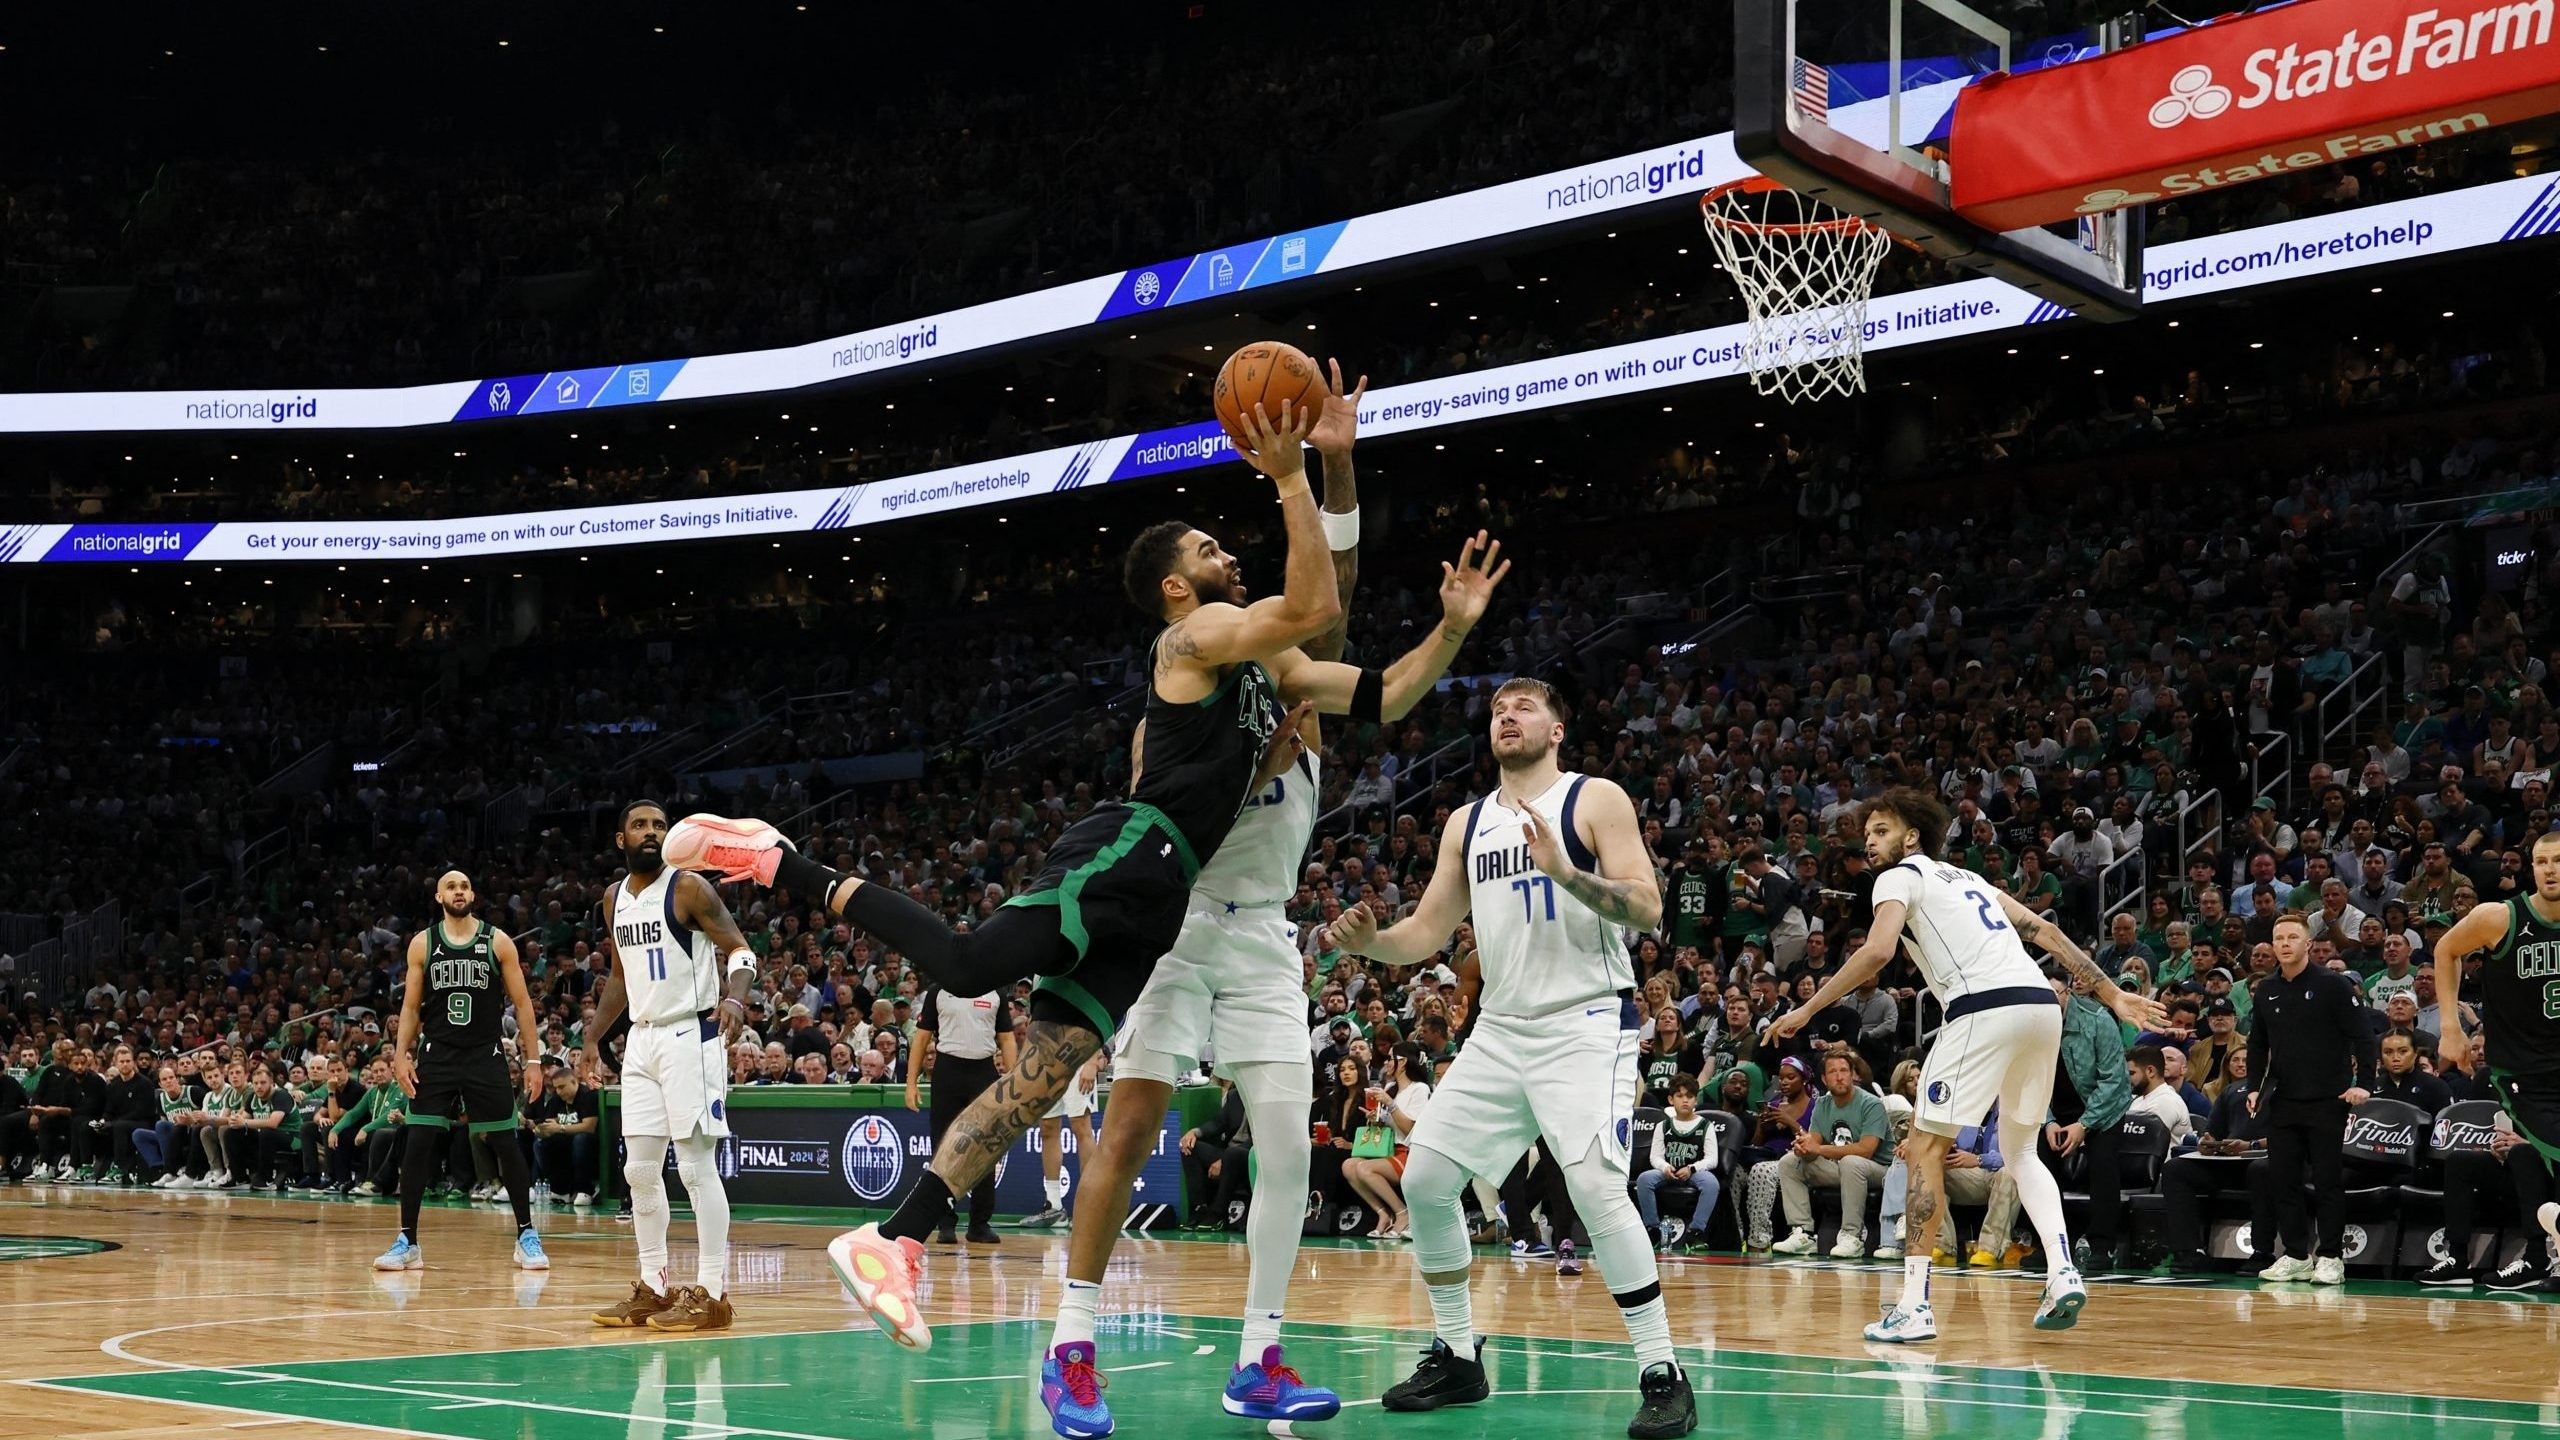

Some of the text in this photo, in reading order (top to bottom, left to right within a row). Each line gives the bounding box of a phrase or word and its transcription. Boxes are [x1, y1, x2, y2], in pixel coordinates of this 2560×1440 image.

[2238, 0, 2557, 110] State Farm
[2160, 112, 2490, 196] State Farm
[1548, 149, 1704, 210] nationalgrid
[2142, 219, 2433, 287] ngrid.com/heretohelp
[833, 324, 937, 368] nationalgrid
[1382, 386, 1510, 421] energy-saving
[1516, 376, 1569, 402] game
[1574, 371, 1598, 388] on
[1604, 359, 1646, 382] with
[1652, 356, 1687, 374] our
[1896, 299, 2001, 332] Initiative.
[187, 395, 317, 424] nationalgrid
[881, 469, 1031, 511] ngrid.com/heretohelp
[73, 529, 181, 555] nationalgrid
[246, 505, 798, 552] Get your energy-saving game on with our Customer Savings Initiative.
[1476, 843, 1535, 884] DALLA
[1512, 875, 1556, 924] 77
[1679, 880, 1707, 895] CELTICS
[1679, 895, 1706, 914] 33
[1965, 889, 2008, 931] 2
[615, 920, 662, 948] DALLAS
[430, 959, 490, 991] CELTICS
[646, 947, 666, 981] 11
[447, 992, 473, 1026] 9
[1633, 1119, 1656, 1131] ltics
[2122, 1121, 2147, 1135] tics
[2343, 1117, 2415, 1146] Finals
[2435, 1121, 2498, 1150] Fina
[739, 1146, 788, 1167] FINAL
[789, 1151, 814, 1163] 2024
[851, 1145, 895, 1169] OILERS
